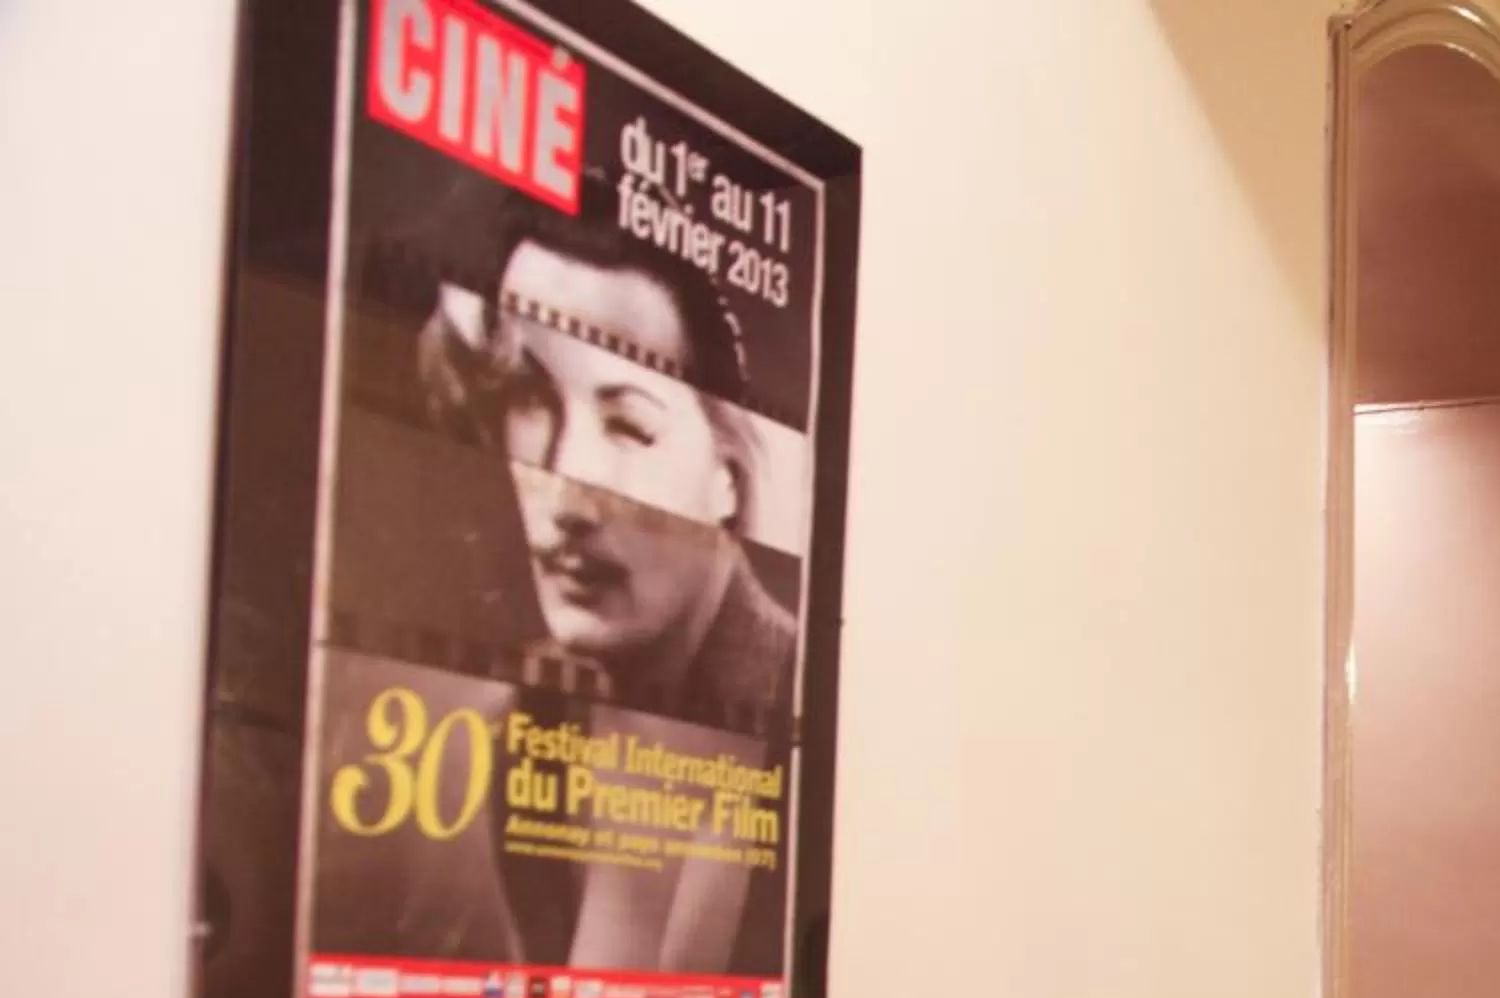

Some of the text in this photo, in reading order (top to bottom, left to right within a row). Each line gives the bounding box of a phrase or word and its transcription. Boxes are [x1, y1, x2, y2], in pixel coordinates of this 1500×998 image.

[379, 0, 580, 199] CINÉ
[617, 172, 790, 308] février 2013
[620, 116, 792, 253] du 1er au 11
[506, 757, 779, 844] du Premier Film
[508, 711, 783, 799] Festival International
